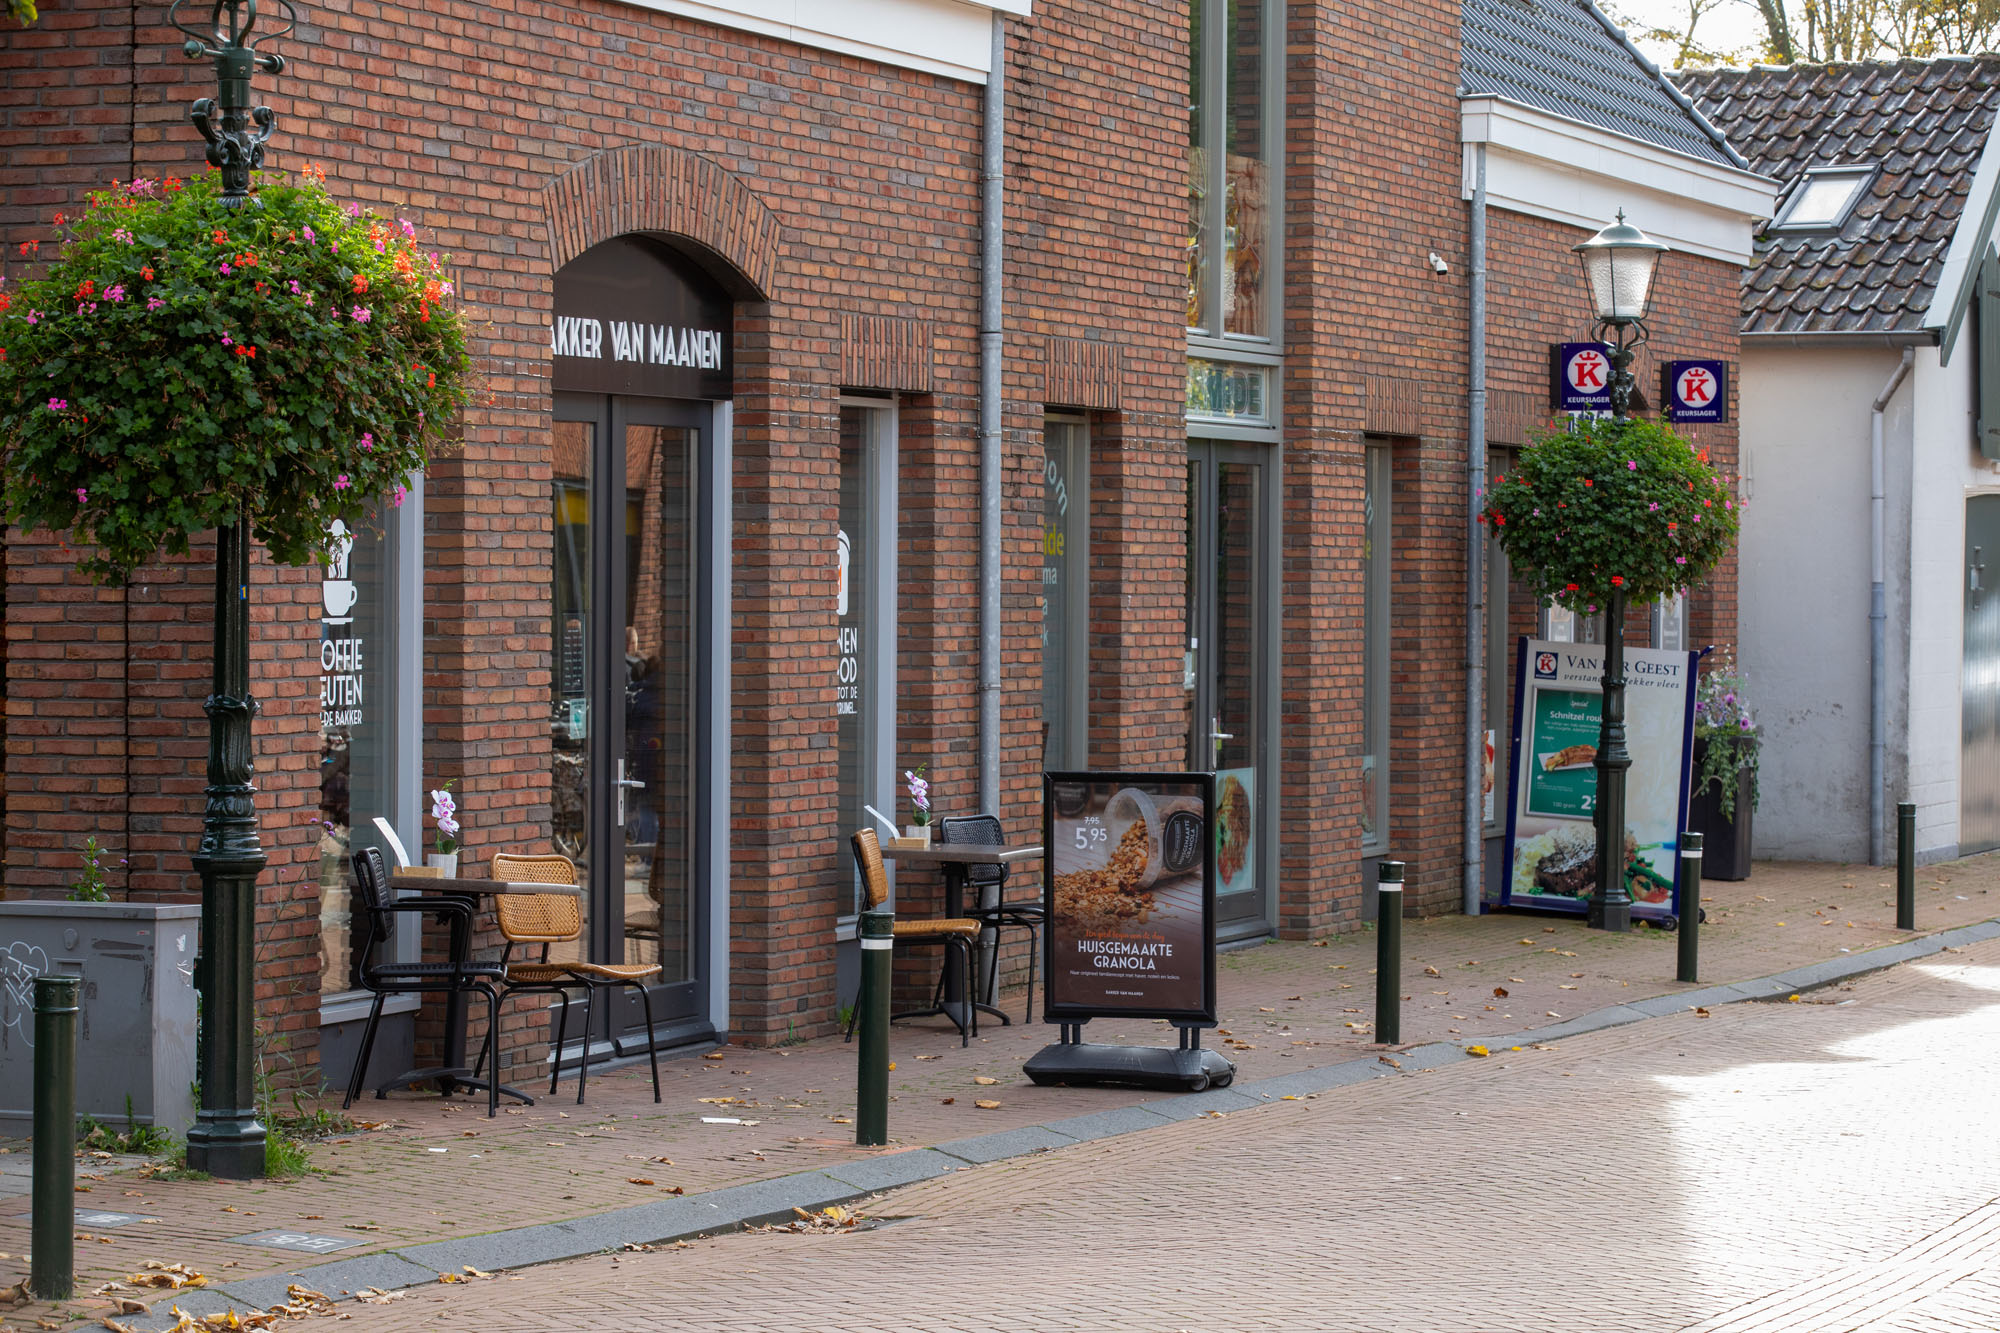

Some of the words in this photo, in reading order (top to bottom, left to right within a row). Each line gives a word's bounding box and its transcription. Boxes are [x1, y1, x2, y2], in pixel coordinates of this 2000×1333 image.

[609, 320, 644, 364] VAN
[650, 324, 721, 370] MAANEN
[319, 639, 362, 671] OFFIE
[837, 657, 857, 683] OD
[1567, 655, 1599, 670] VAN
[1635, 661, 1680, 676] GEEST
[1657, 680, 1679, 688] vlees
[837, 686, 849, 699] TOT
[850, 686, 858, 699] DE
[324, 711, 333, 726] DE
[335, 710, 362, 726] BAKKER
[1550, 710, 1584, 720] Schnitzel
[1084, 817, 1100, 825] 7,95
[1078, 940, 1172, 956] HUISGEMAAKTE
[1094, 955, 1156, 970] GRANOLA
